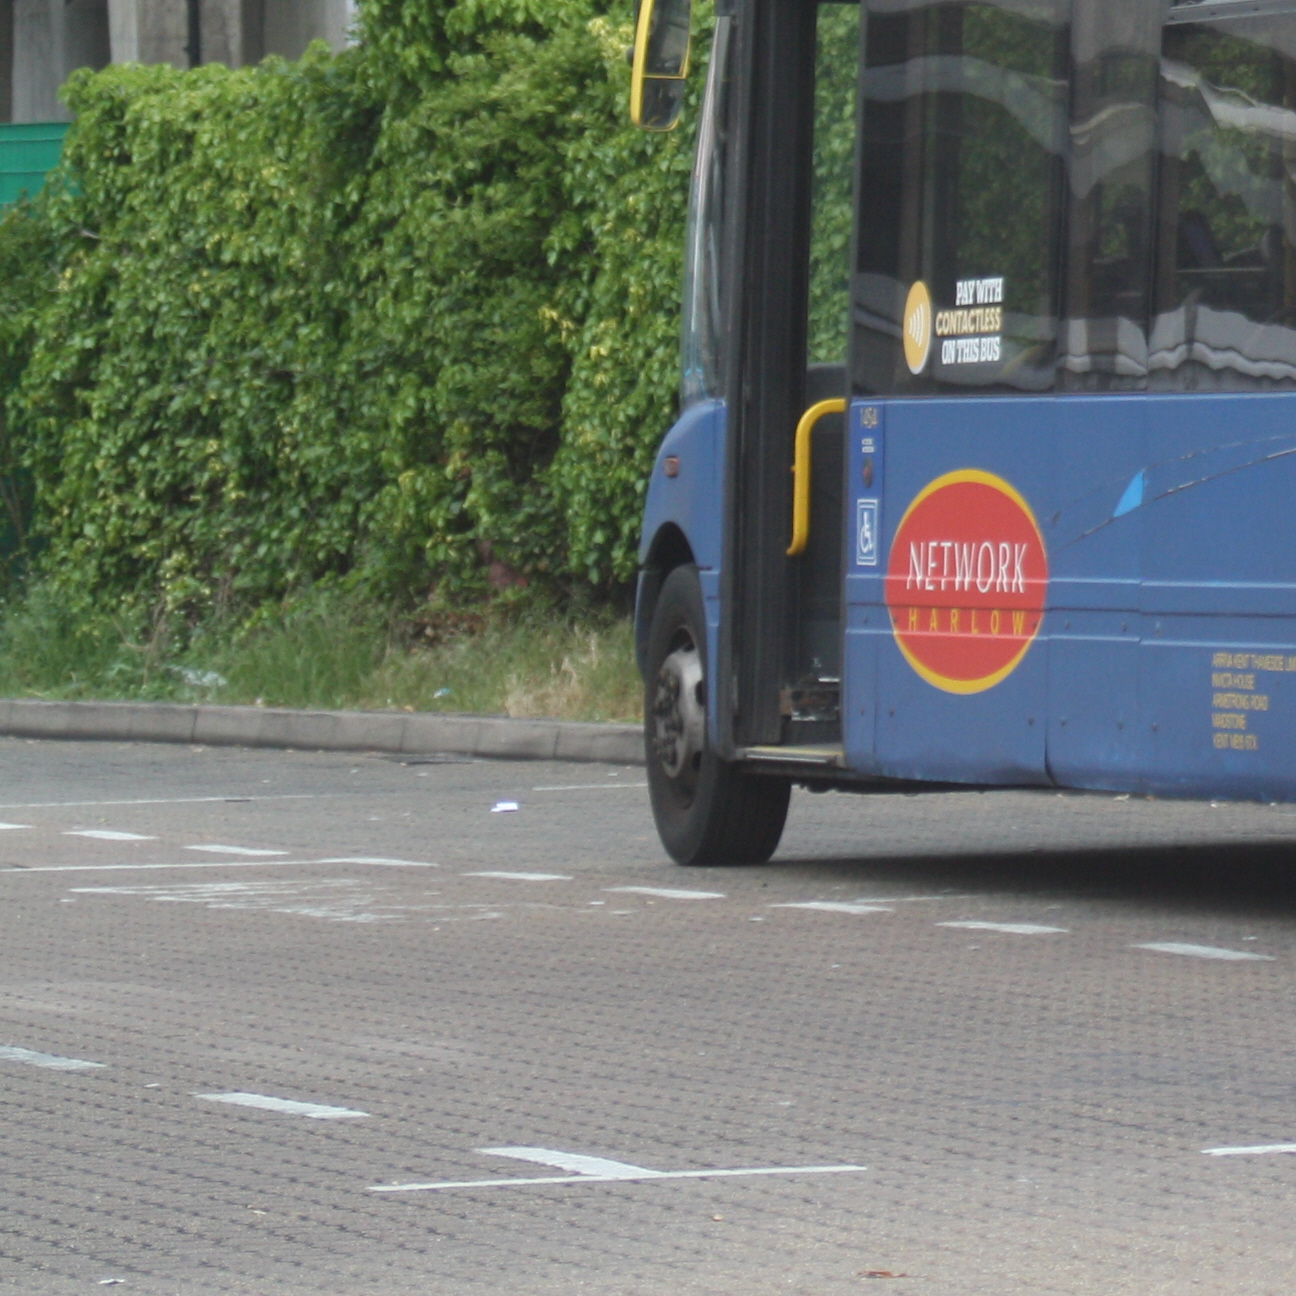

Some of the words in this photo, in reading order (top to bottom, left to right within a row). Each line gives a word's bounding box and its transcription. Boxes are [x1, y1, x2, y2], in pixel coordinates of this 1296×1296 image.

[955, 281, 976, 306] PAY
[976, 277, 1003, 305] WITH
[935, 306, 1002, 336] CONTACTLESS
[942, 340, 956, 364] ON
[957, 338, 980, 364] THIS
[980, 336, 1001, 363] BUS
[906, 541, 1028, 593] NETWORK
[908, 607, 1026, 636] HARLOW
